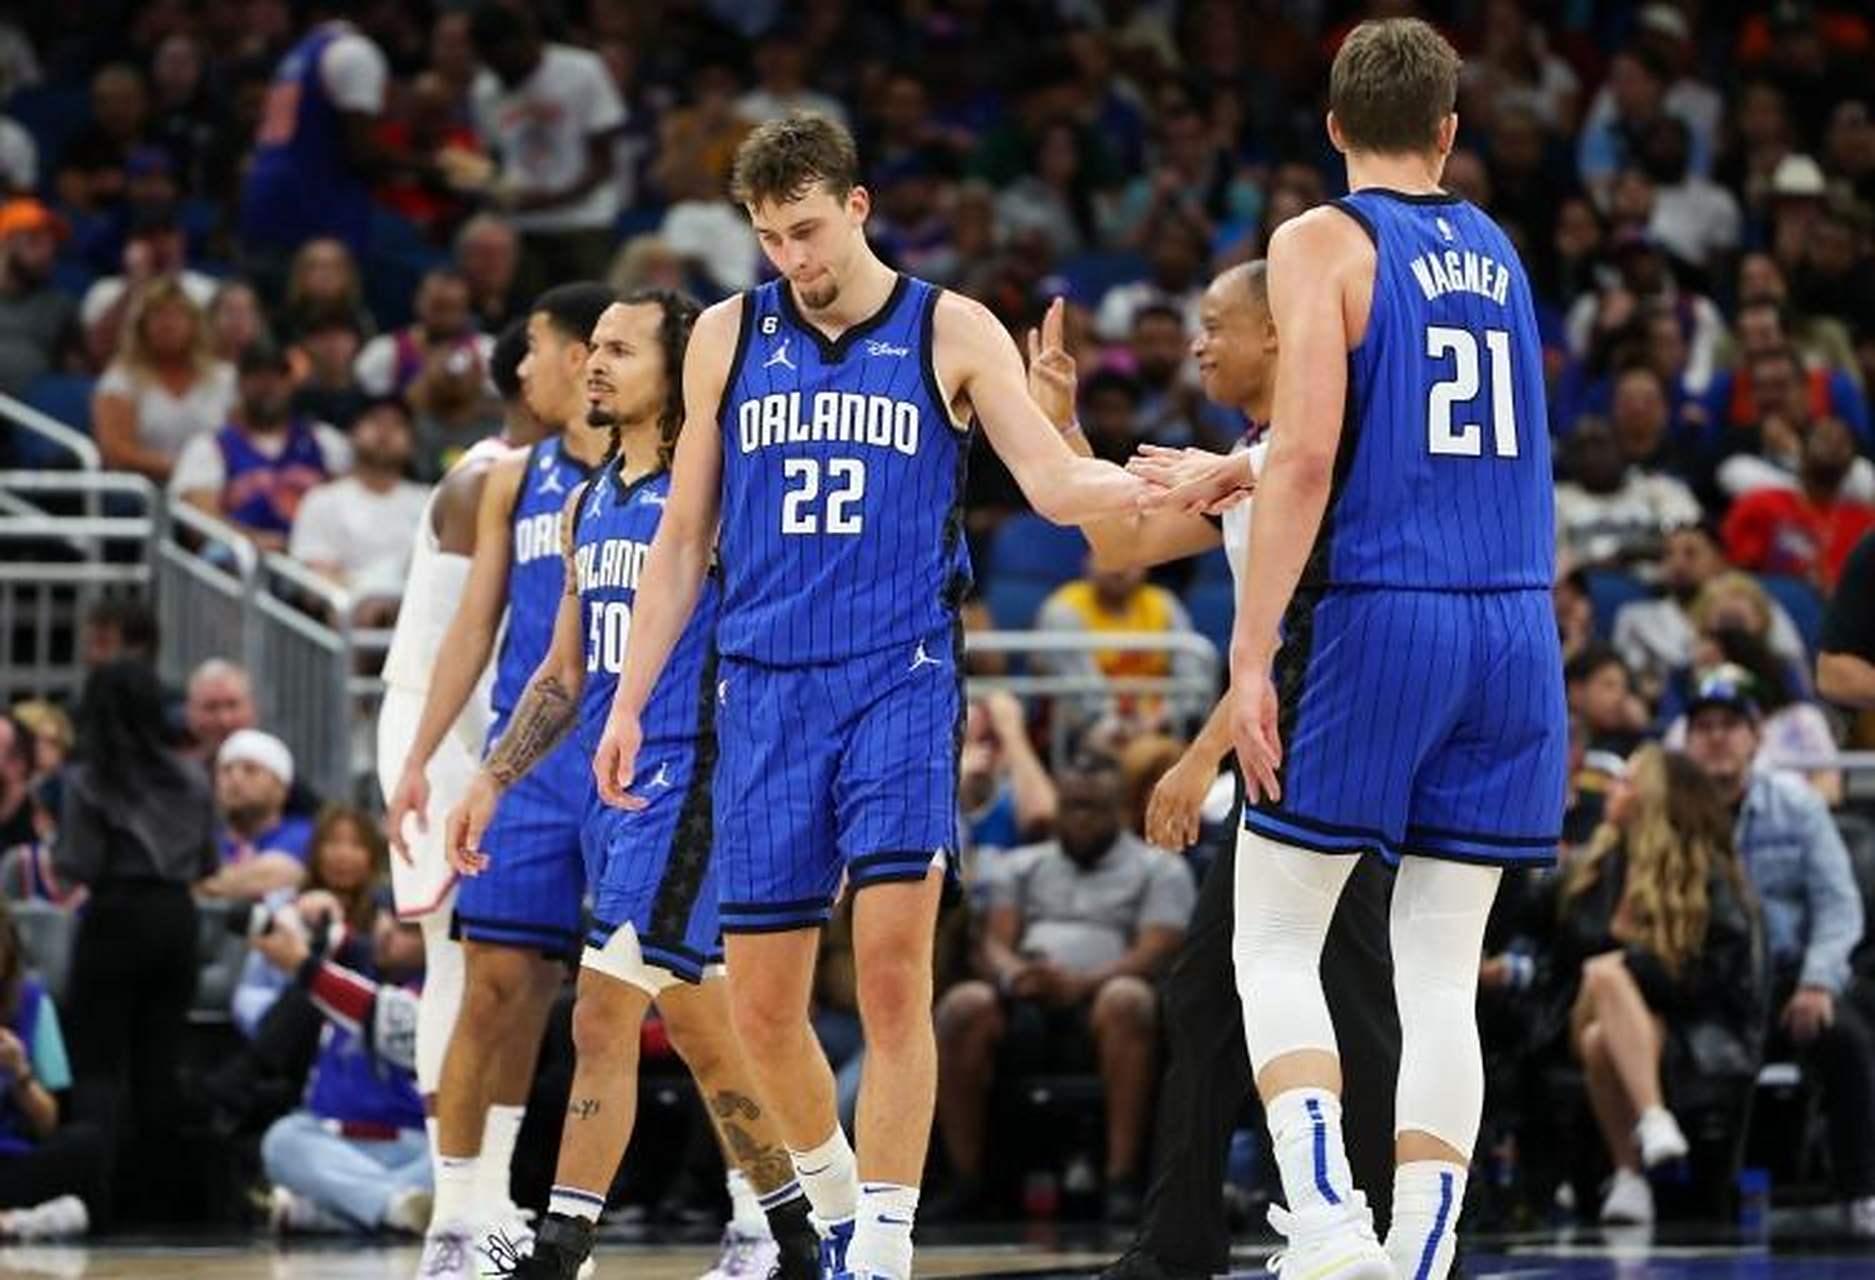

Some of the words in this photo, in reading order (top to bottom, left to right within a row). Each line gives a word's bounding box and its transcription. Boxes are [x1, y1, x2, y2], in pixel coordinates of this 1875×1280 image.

[1409, 250, 1510, 306] WAGNER
[761, 316, 778, 334] 6
[739, 391, 919, 455] ORLANDO
[1427, 326, 1518, 457] 21
[782, 458, 865, 534] 22
[587, 601, 631, 674] 50
